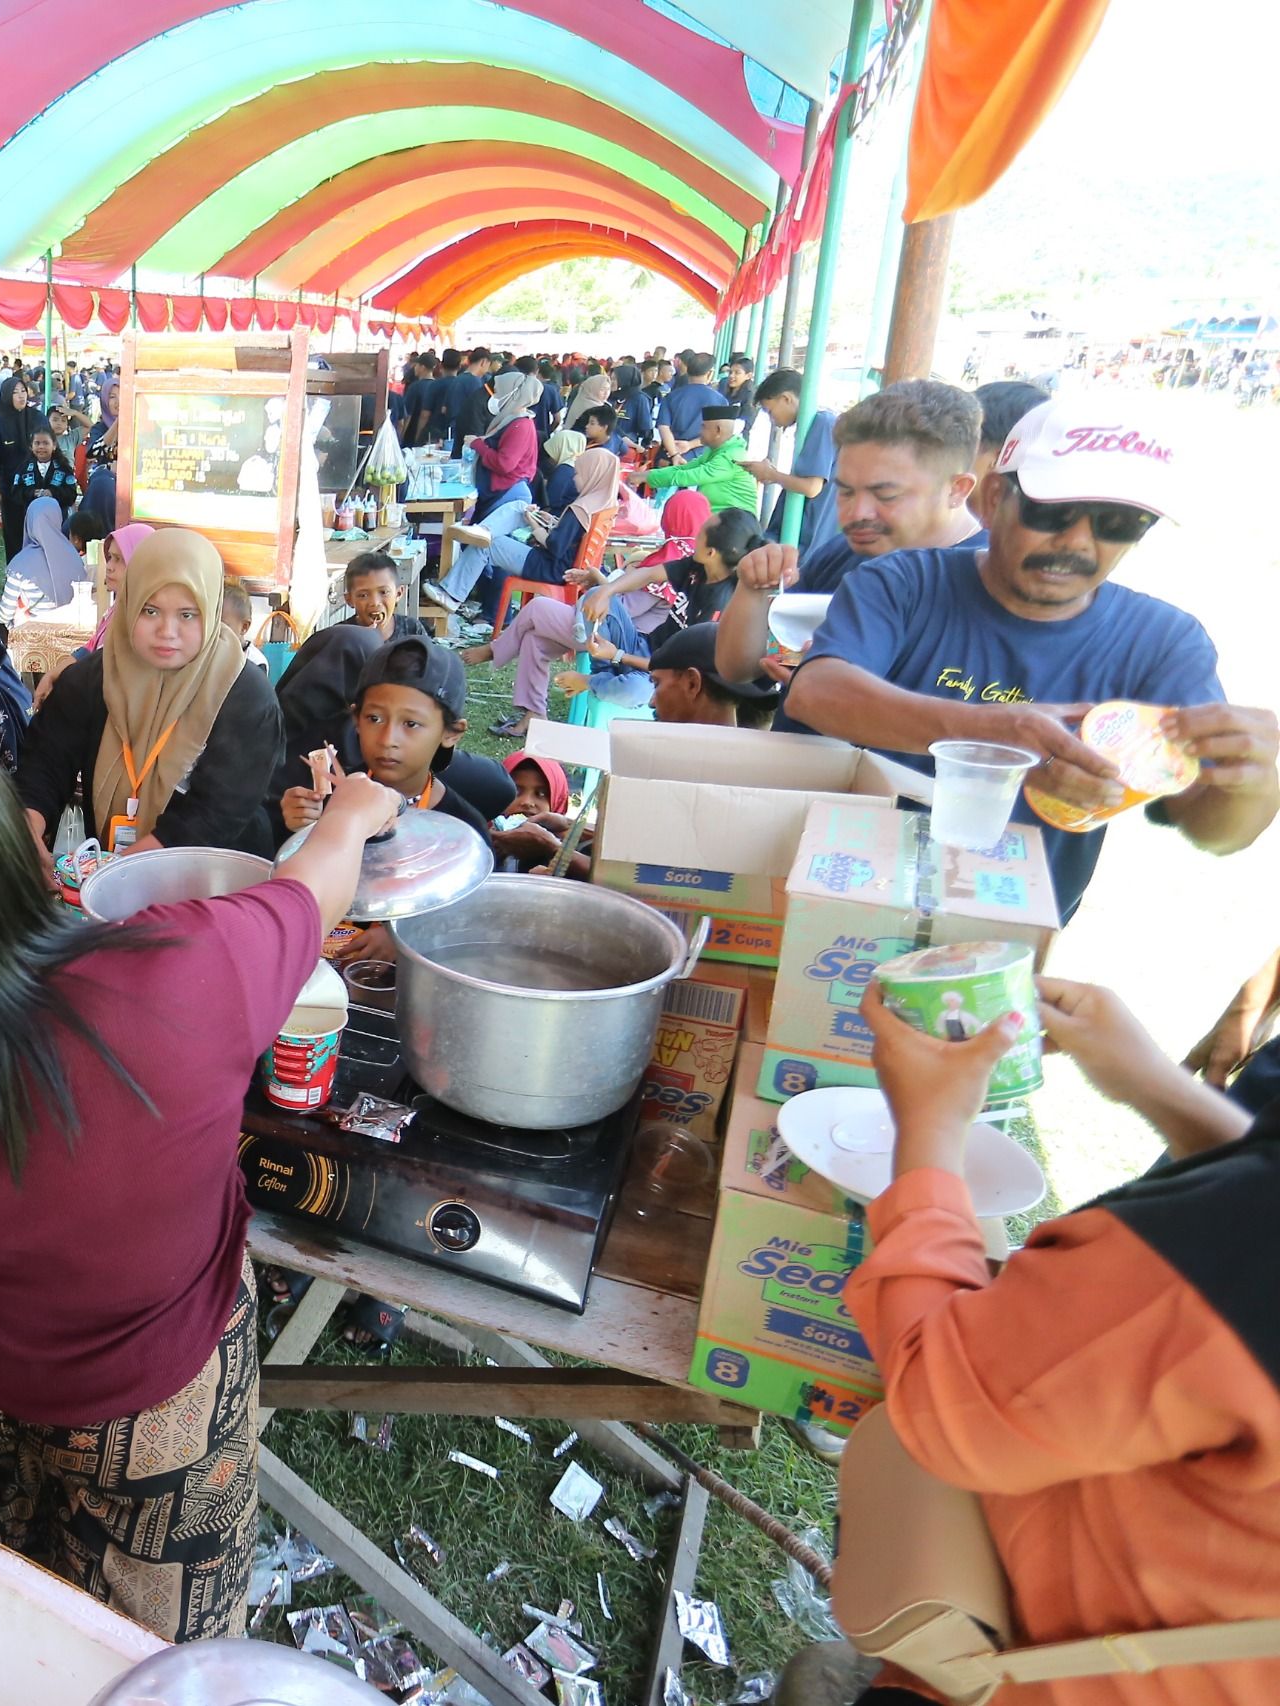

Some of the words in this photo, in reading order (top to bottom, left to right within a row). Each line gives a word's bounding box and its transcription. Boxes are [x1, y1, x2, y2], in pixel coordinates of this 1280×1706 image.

[1052, 425, 1174, 465] Titleist
[936, 668, 976, 701] Family
[664, 871, 702, 885] Soto
[735, 933, 772, 948] Cups
[832, 935, 878, 953] Mie
[805, 950, 878, 986] Se
[782, 1072, 807, 1097] 8
[658, 1110, 693, 1124] Mie
[259, 1157, 295, 1177] Rinnai
[257, 1173, 288, 1193] Ceflon
[767, 1236, 813, 1257] Mie
[801, 1325, 851, 1349] Soto
[714, 1361, 739, 1383] 8
